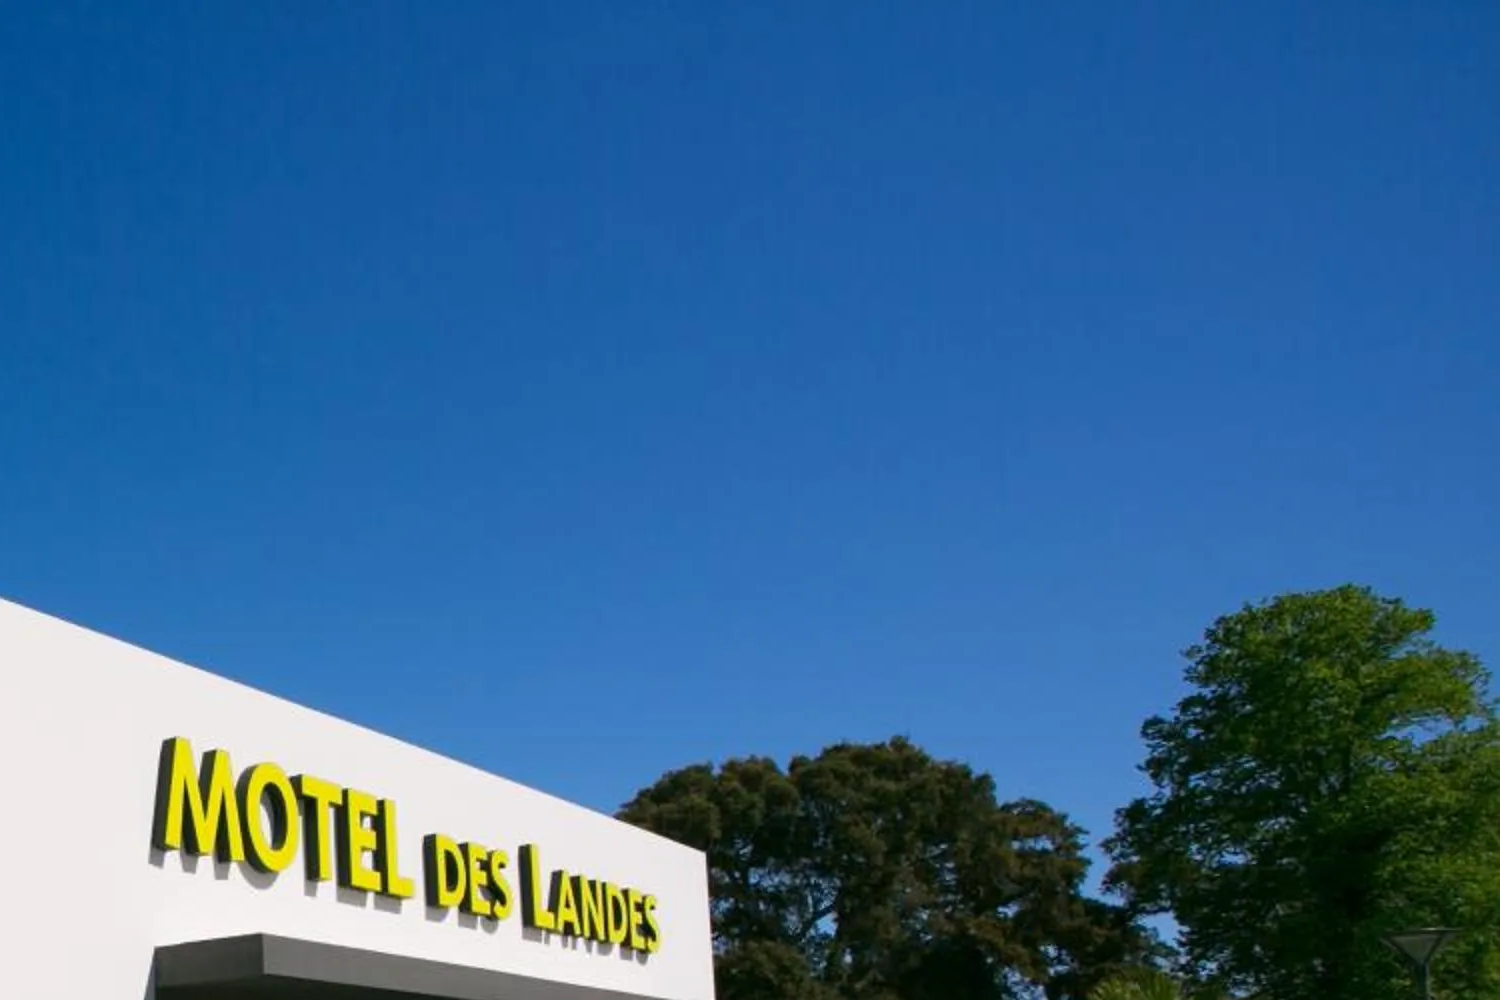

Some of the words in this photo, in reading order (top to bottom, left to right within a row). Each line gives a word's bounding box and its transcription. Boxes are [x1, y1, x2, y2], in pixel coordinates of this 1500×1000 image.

[154, 736, 415, 899] MOTEL
[425, 834, 514, 920] DES
[520, 844, 661, 953] LANDES
